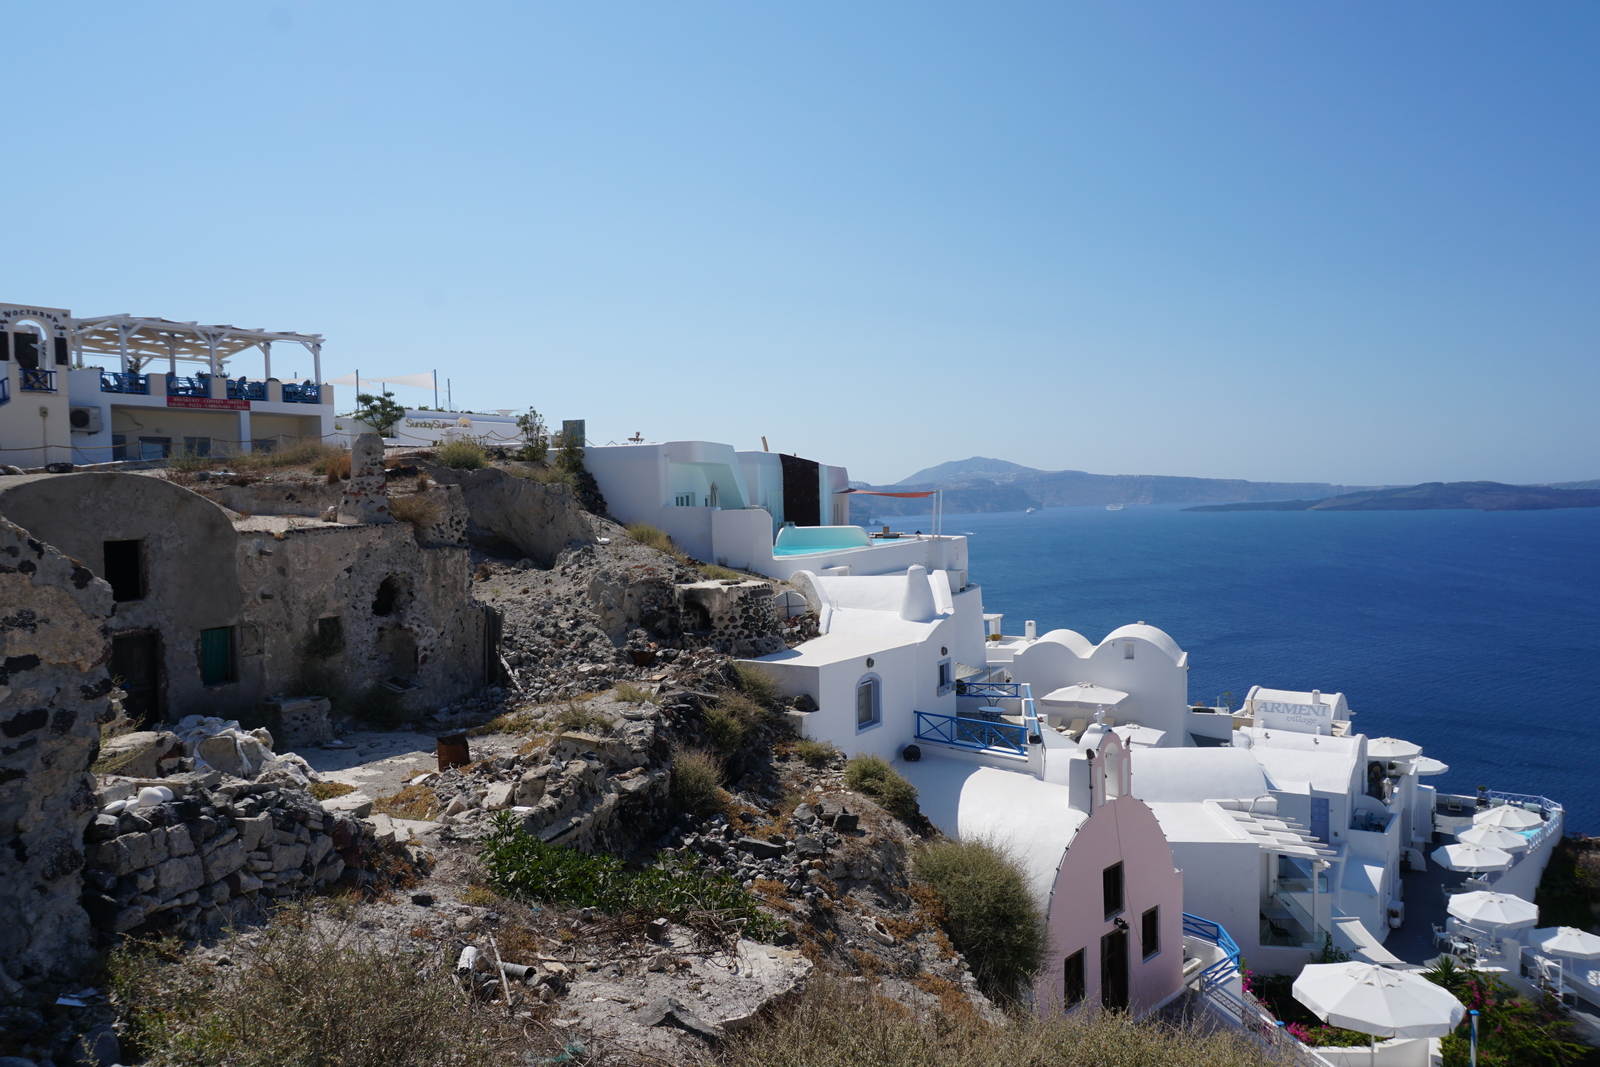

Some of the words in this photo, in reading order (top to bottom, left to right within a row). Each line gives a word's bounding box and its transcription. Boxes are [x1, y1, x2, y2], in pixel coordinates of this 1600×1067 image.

[3, 310, 58, 323] NOCTURNA
[1257, 702, 1327, 717] ARMENI
[1286, 715, 1317, 725] village
